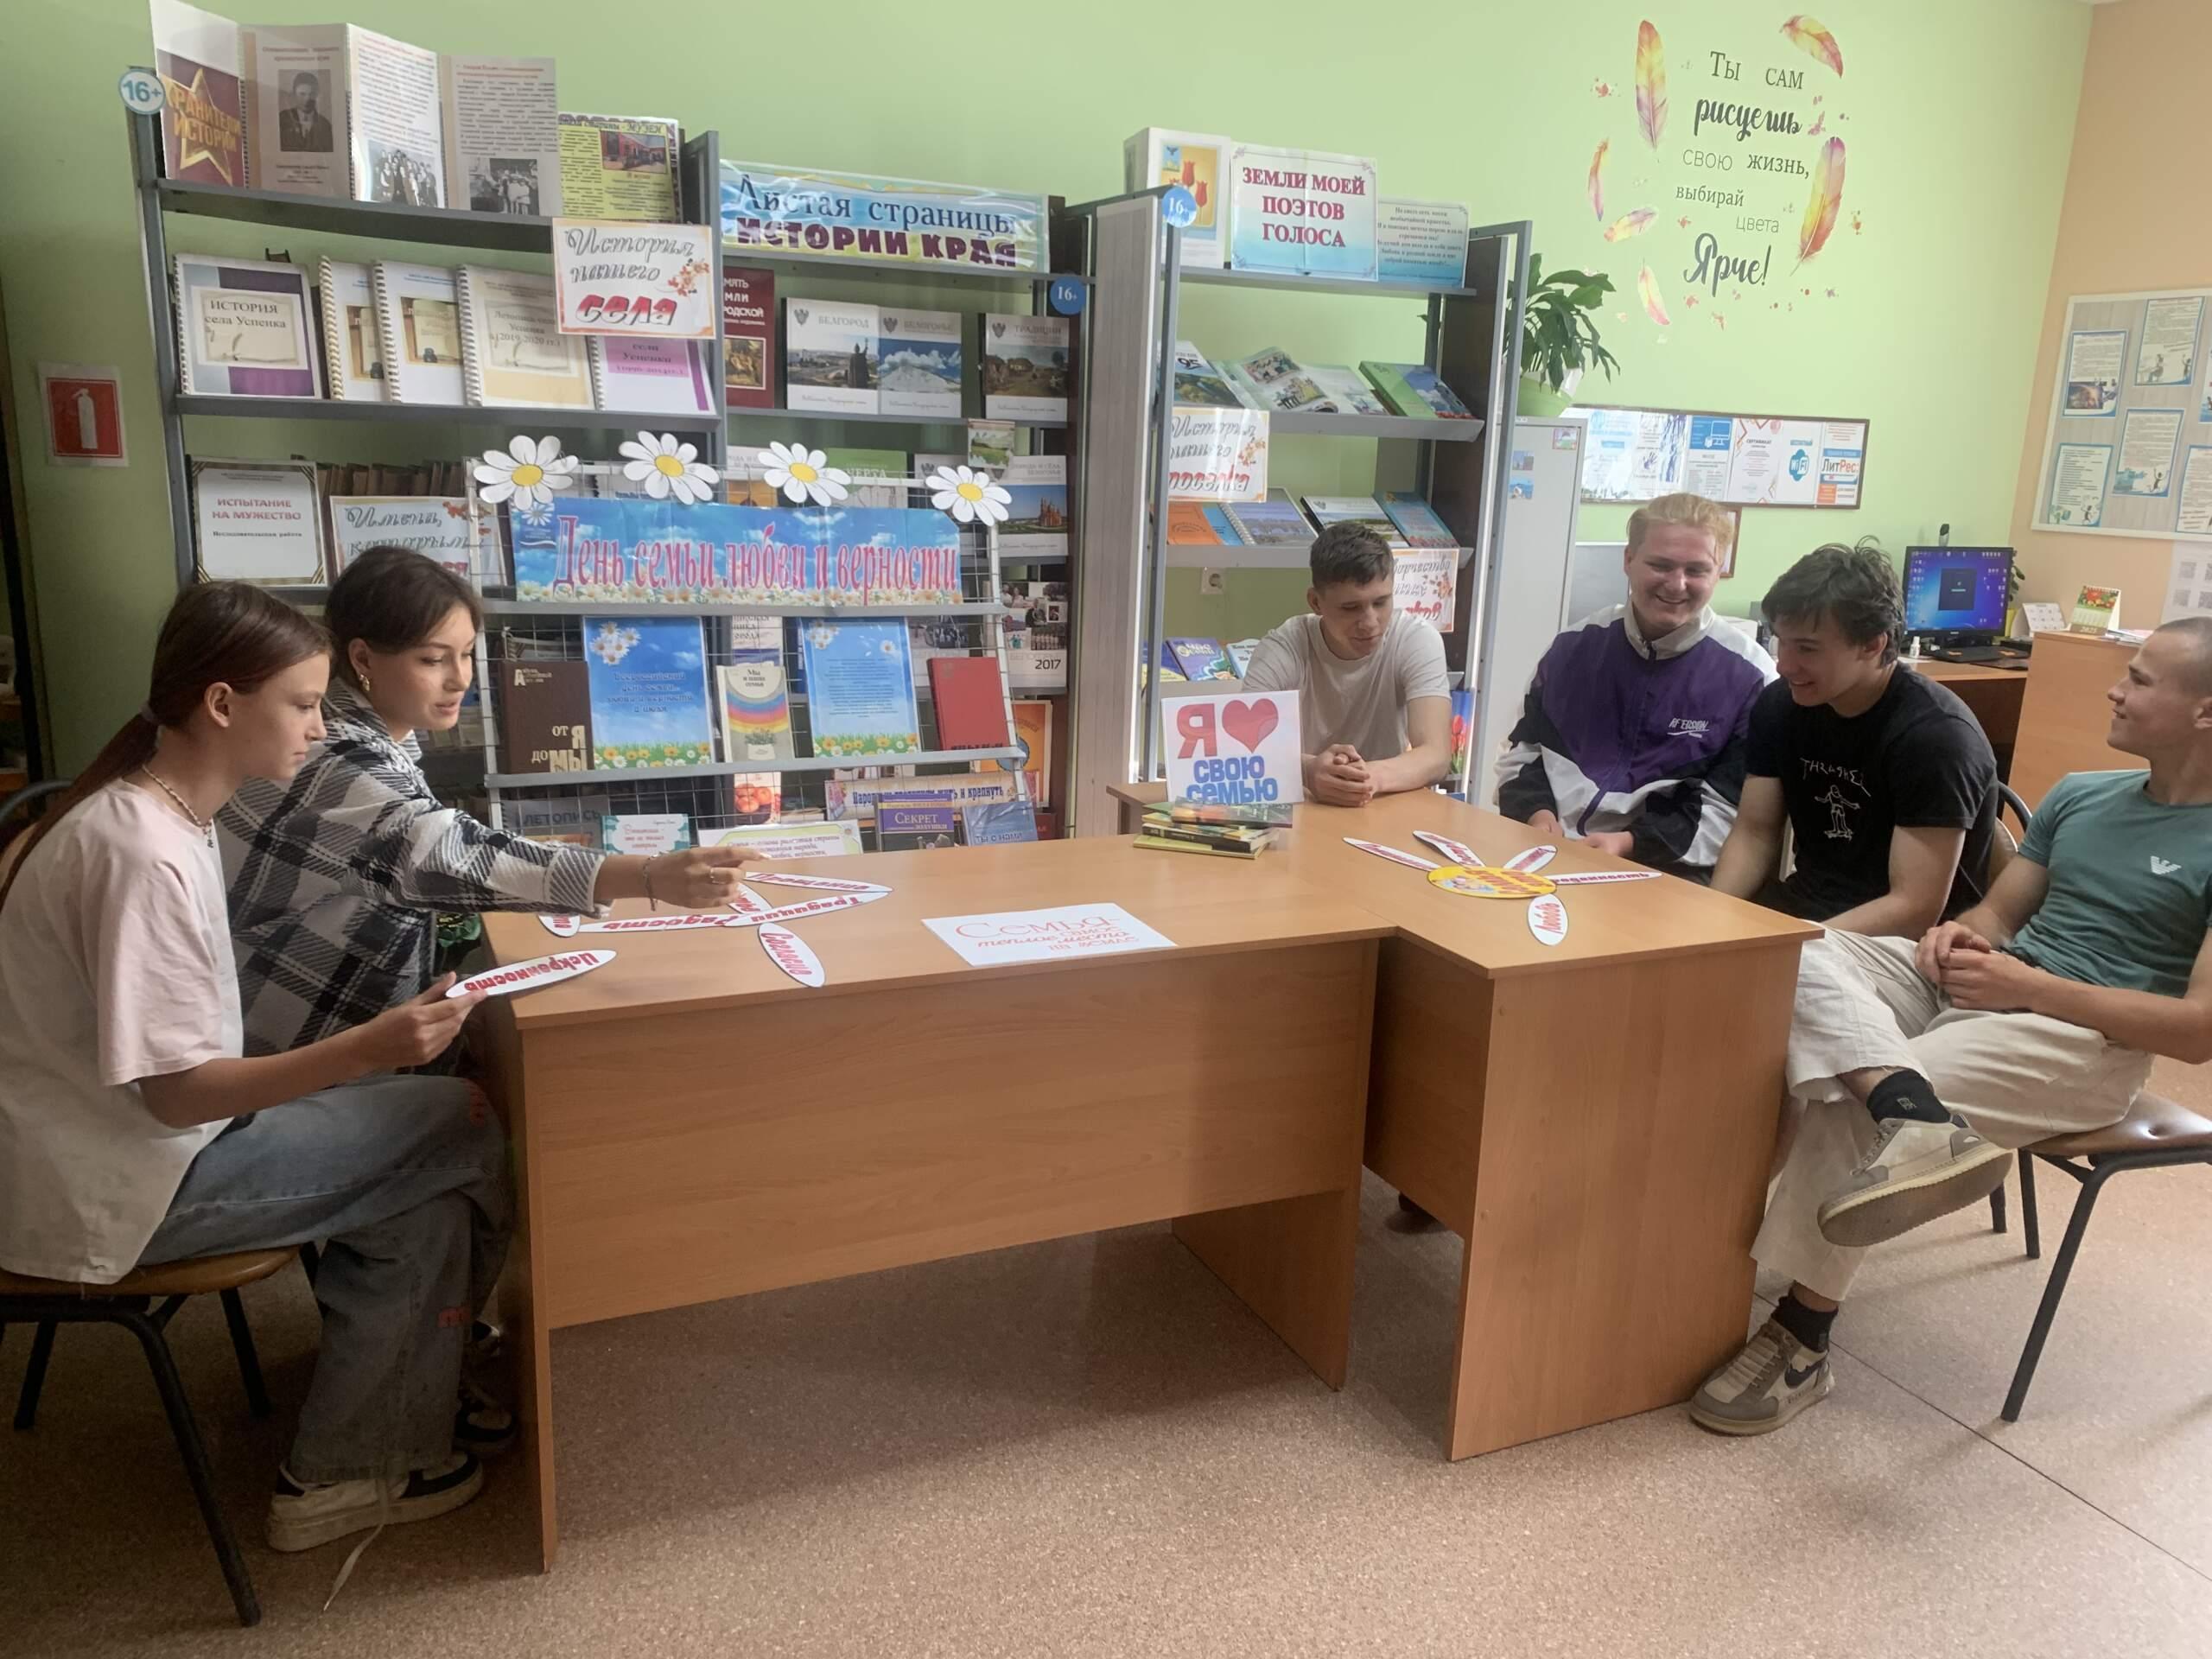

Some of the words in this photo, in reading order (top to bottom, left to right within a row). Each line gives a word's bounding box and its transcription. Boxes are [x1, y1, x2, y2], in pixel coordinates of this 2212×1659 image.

[1710, 51, 1741, 80] Ты
[123, 80, 162, 102] 16+
[1694, 98, 1802, 141] рисуешь
[1243, 167, 1307, 189] ЗЕМЛИ
[1312, 175, 1366, 195] МОЕЙ
[1675, 185, 1745, 208] выбирай
[868, 200, 1018, 238] страницы
[1262, 196, 1344, 220] ПОЭТОВ
[1262, 222, 1346, 248] ГОЛОСА
[1736, 215, 1779, 233] цвета
[564, 227, 695, 263] История
[736, 217, 908, 256] ИСТОРИИ
[921, 233, 1016, 268] КРАЯ
[569, 264, 661, 283] нашего
[1683, 232, 1772, 297] Ярче!
[724, 278, 749, 289] МЯТЬ
[211, 300, 278, 314] ИСТОРИЯ
[725, 292, 749, 302] МЛИ
[205, 316, 232, 325] села
[236, 315, 287, 328] Успенка
[723, 306, 765, 318] РОДСКОЙ
[818, 315, 869, 328] БЕЛГОРОД
[217, 498, 291, 508] ИСПЫТАНИЕ
[213, 511, 230, 519] НА
[233, 512, 302, 520] МУЖЕСТВО
[350, 536, 484, 556] которым
[553, 516, 624, 596] День
[635, 540, 715, 588] семьи
[723, 522, 805, 590] любви
[817, 543, 829, 590] и
[836, 544, 958, 606] верности
[1035, 659, 1061, 670] 2017
[571, 726, 586, 749] Я
[1177, 703, 1217, 759] Я
[549, 749, 588, 772] МЫ
[960, 788, 965, 798] и
[968, 786, 1003, 800] крепнуть
[524, 810, 601, 825] ЛЕТОПИСЬ
[603, 914, 738, 930] Радость
[464, 951, 600, 993] Искренность
